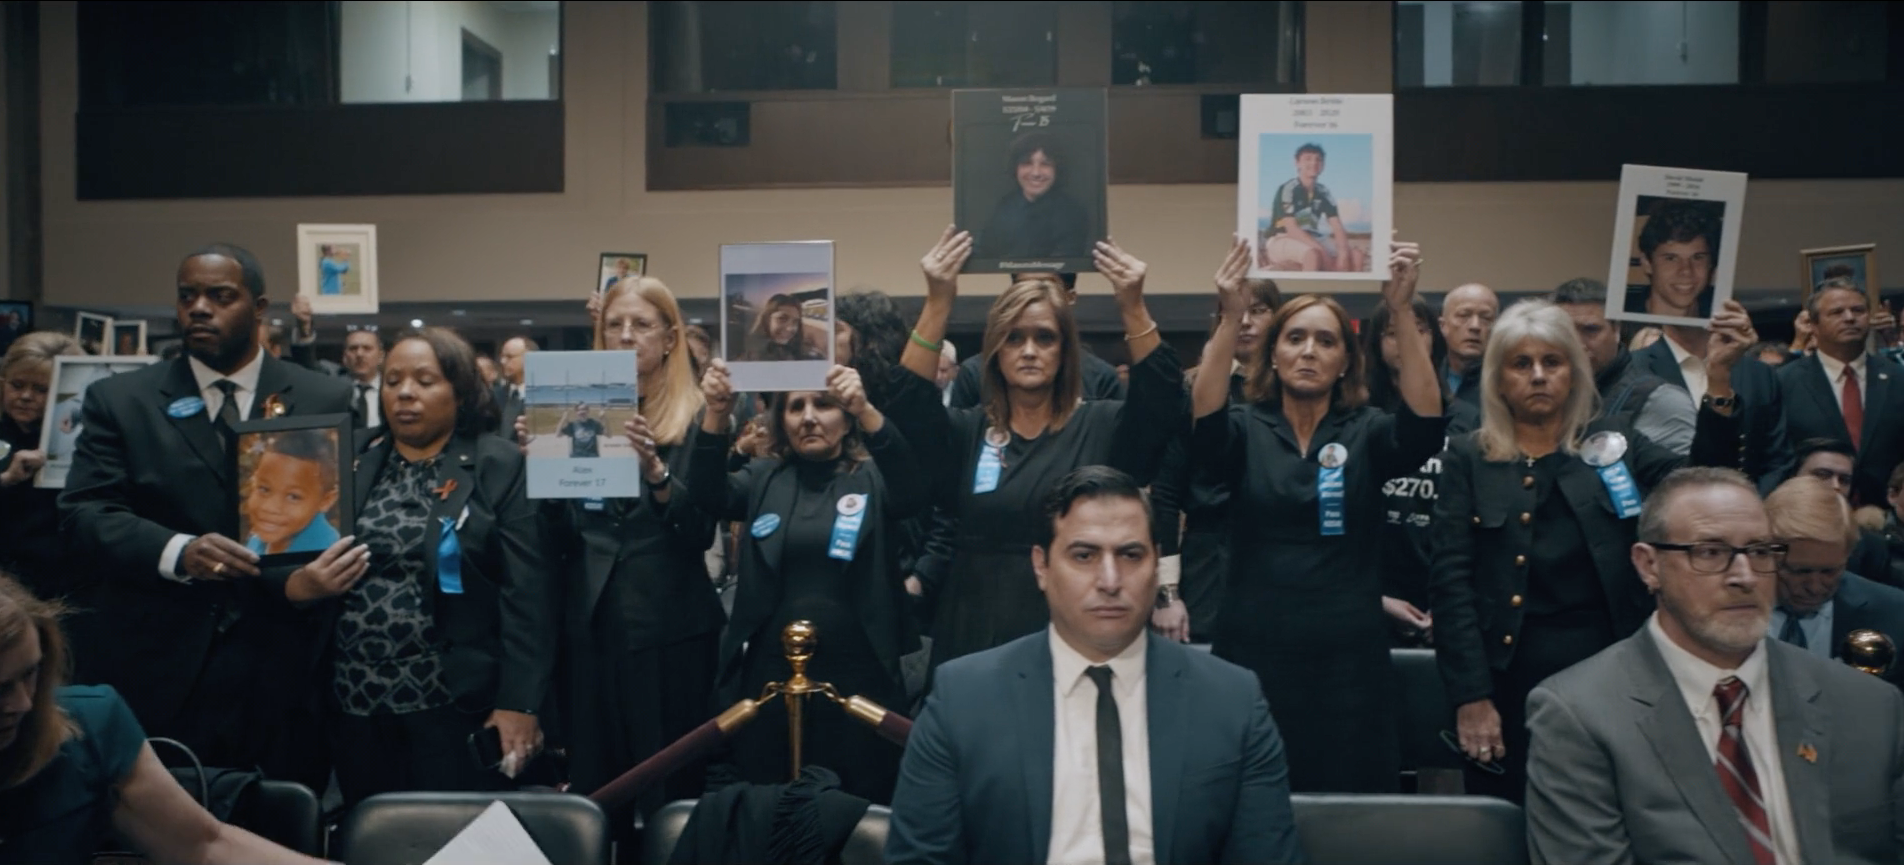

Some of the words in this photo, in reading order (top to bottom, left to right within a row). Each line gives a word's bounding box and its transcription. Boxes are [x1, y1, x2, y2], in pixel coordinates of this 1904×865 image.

[572, 466, 593, 474] Alex
[558, 478, 592, 487] Forever
[595, 478, 606, 487] 17
